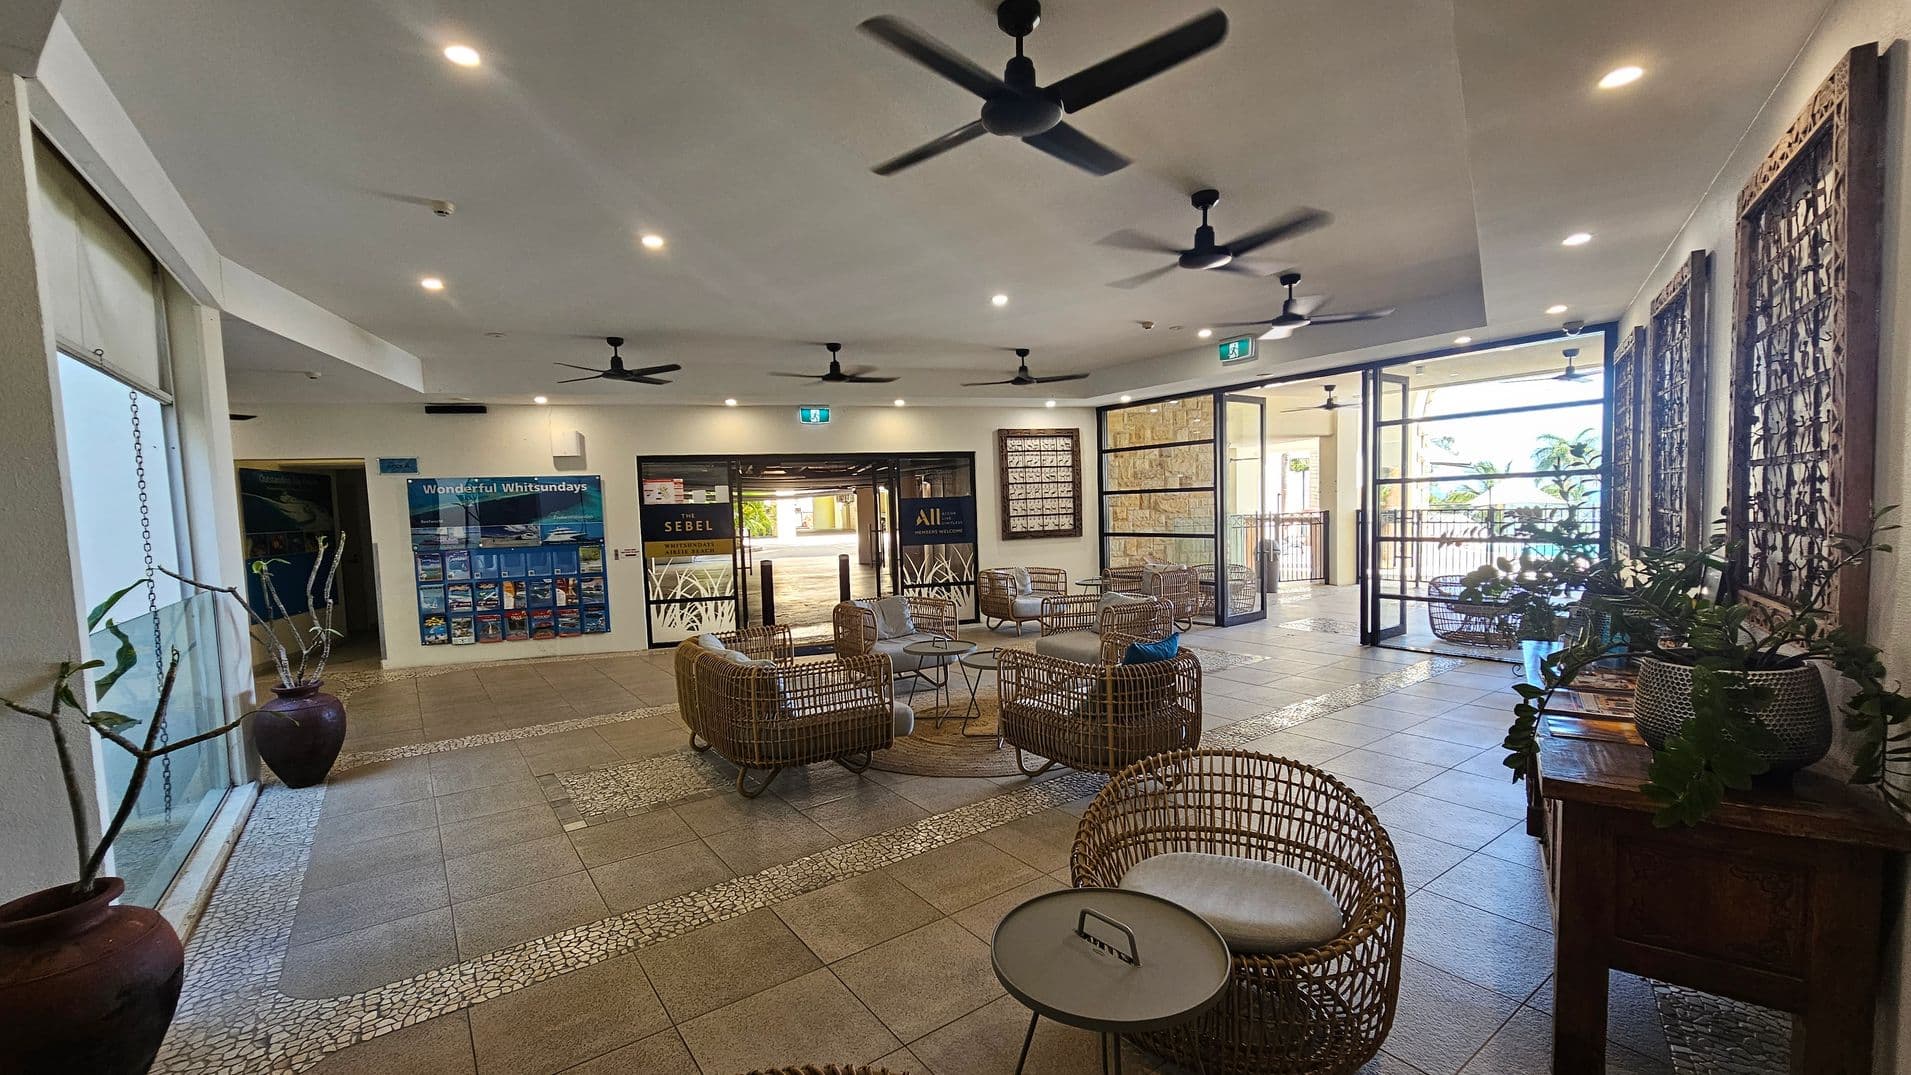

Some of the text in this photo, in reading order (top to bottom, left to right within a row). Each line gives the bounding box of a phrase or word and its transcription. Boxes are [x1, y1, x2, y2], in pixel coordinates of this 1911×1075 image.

[423, 481, 588, 495] Wonderful Whitsundays
[664, 520, 713, 532] SEBEL
